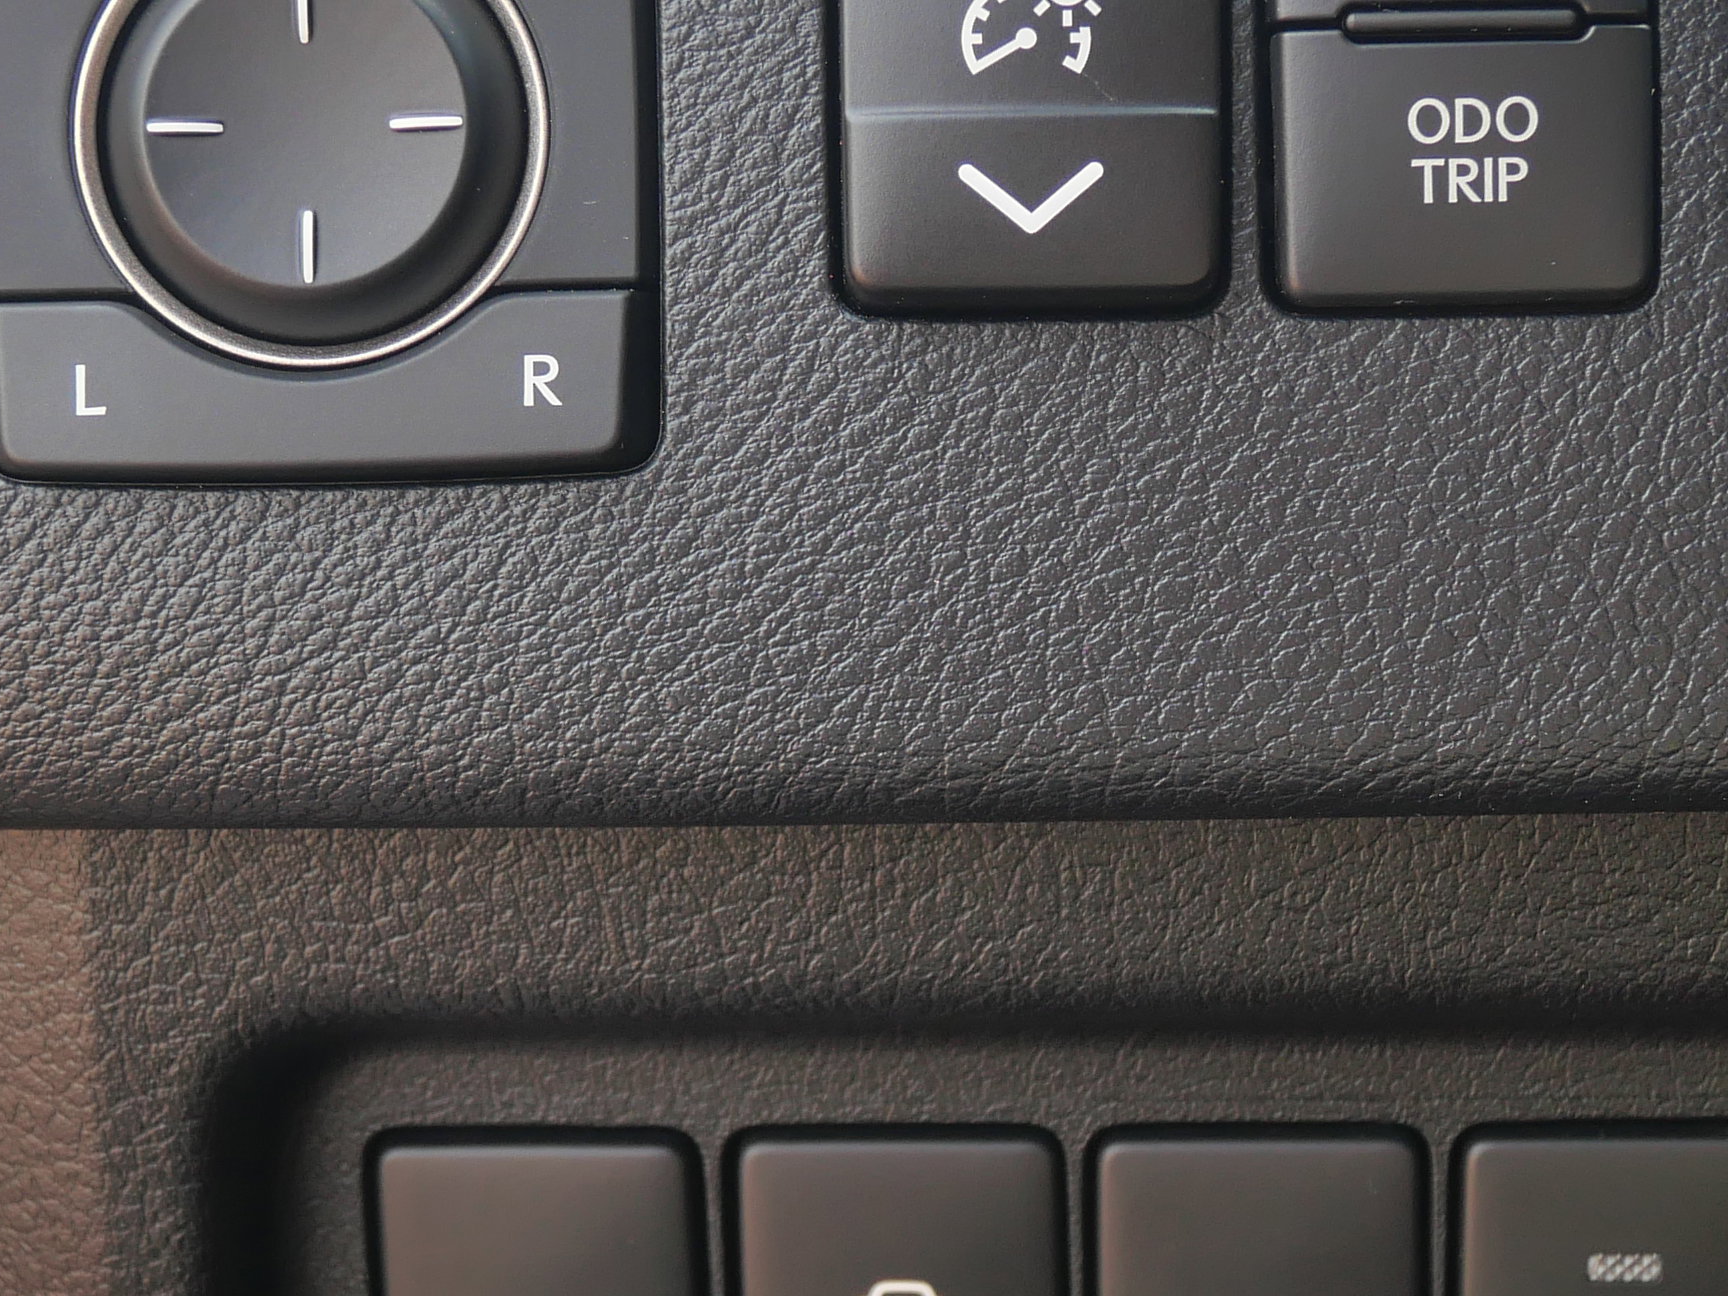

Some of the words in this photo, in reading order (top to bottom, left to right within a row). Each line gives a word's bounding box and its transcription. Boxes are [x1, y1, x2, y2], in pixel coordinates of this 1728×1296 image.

[1406, 94, 1540, 146] ODO
[1410, 155, 1530, 205] TRIP
[74, 363, 108, 417] L
[522, 353, 564, 408] R
